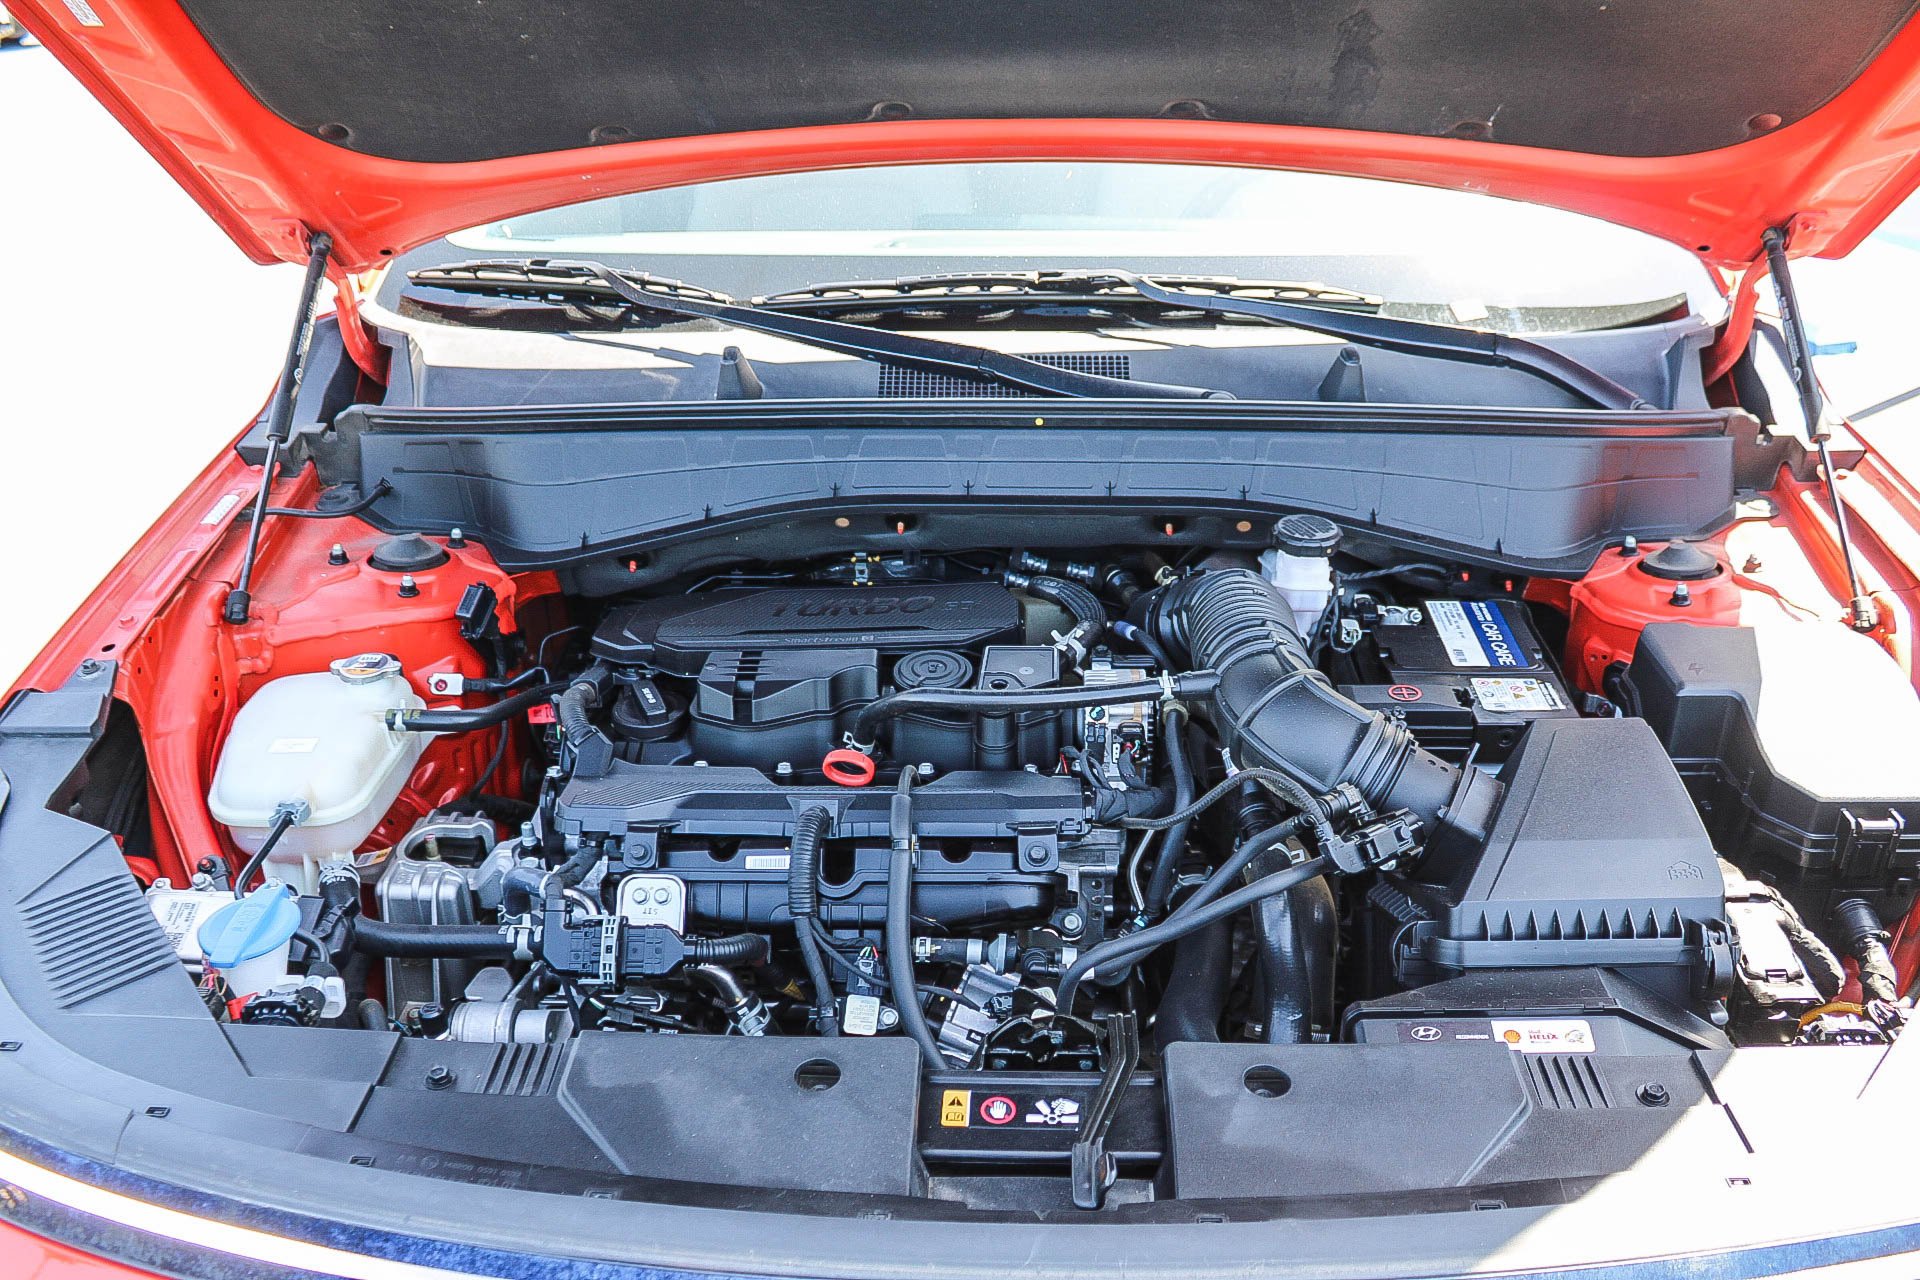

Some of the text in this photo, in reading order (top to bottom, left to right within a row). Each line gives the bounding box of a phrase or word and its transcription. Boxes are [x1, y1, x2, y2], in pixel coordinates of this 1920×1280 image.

[768, 595, 937, 617] TURBO
[1481, 622, 1504, 642] CAR
[1491, 641, 1517, 666] CARE
